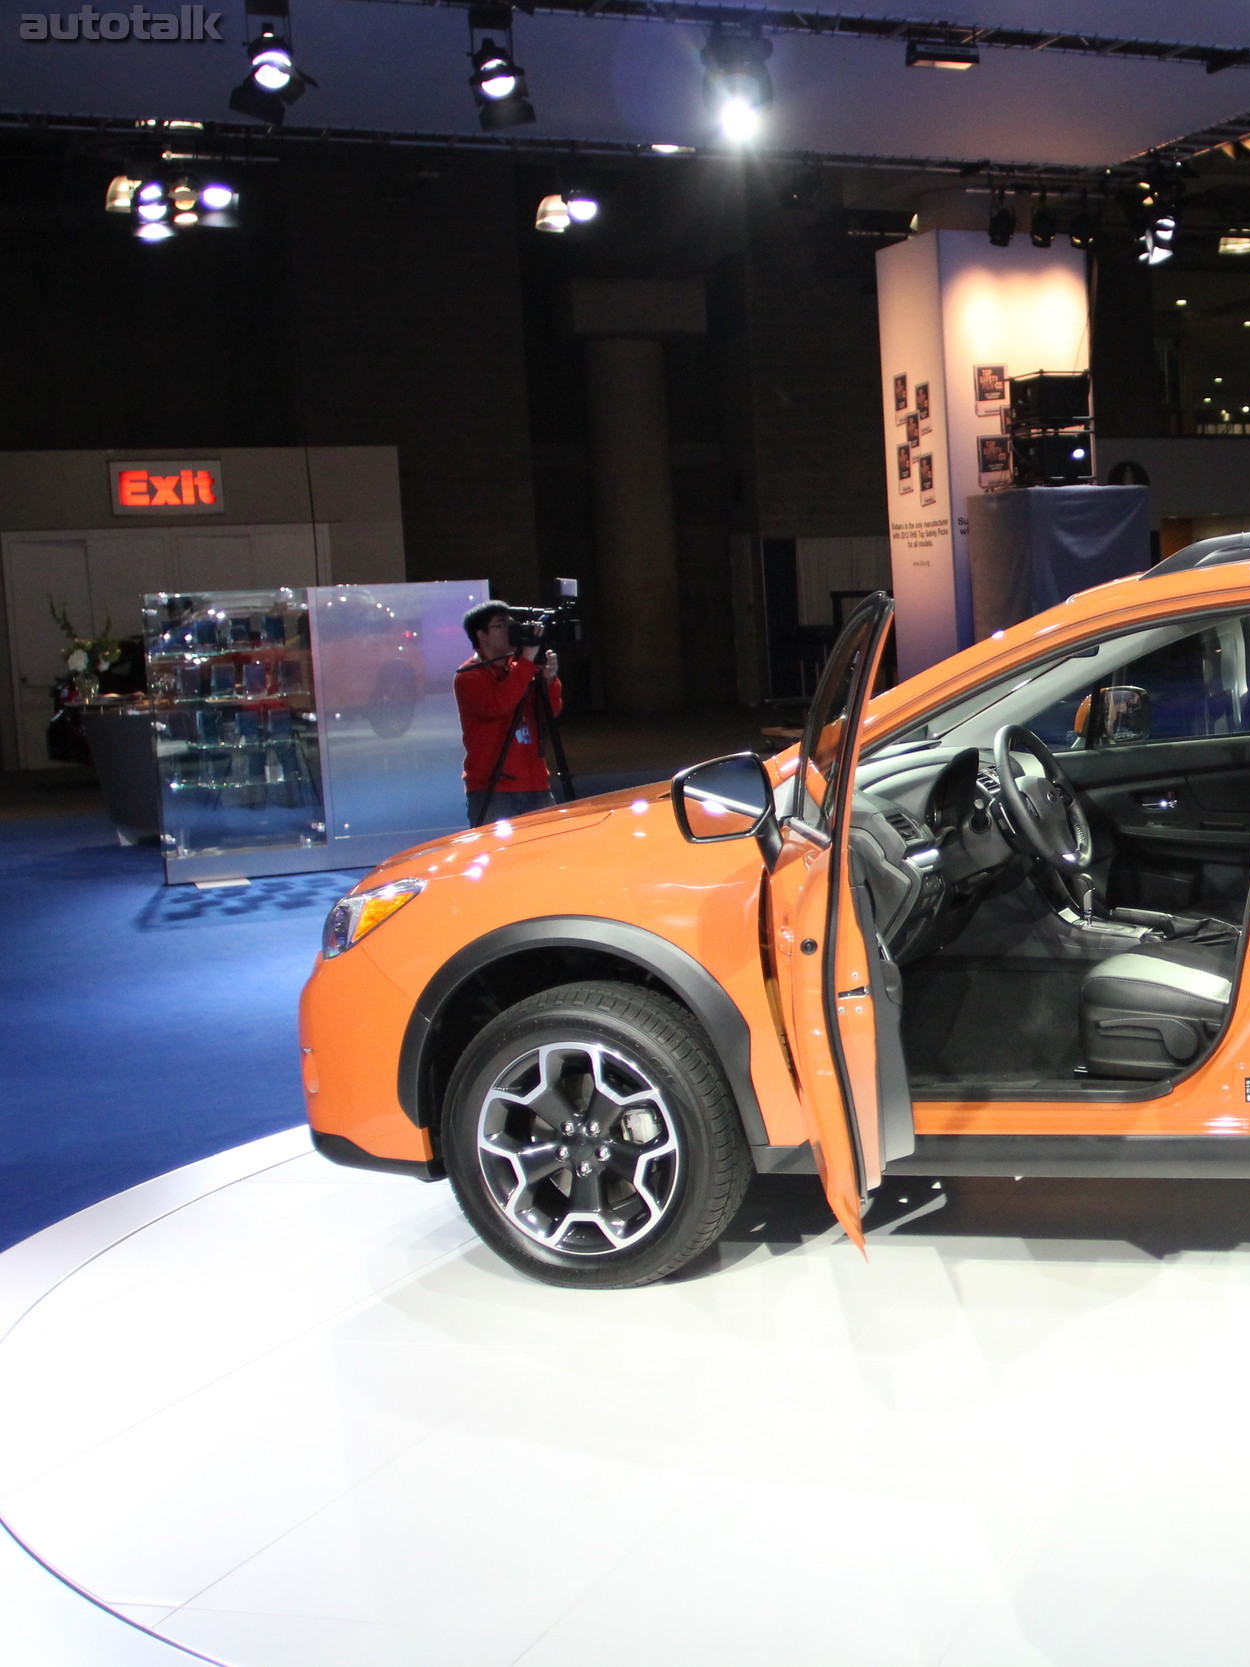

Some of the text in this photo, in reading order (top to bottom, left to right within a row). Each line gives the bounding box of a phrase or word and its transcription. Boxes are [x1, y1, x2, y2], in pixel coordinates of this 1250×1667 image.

[118, 469, 216, 506] Exit
[892, 531, 900, 539] with
[926, 529, 937, 538] Safety
[937, 527, 949, 536] Picks
